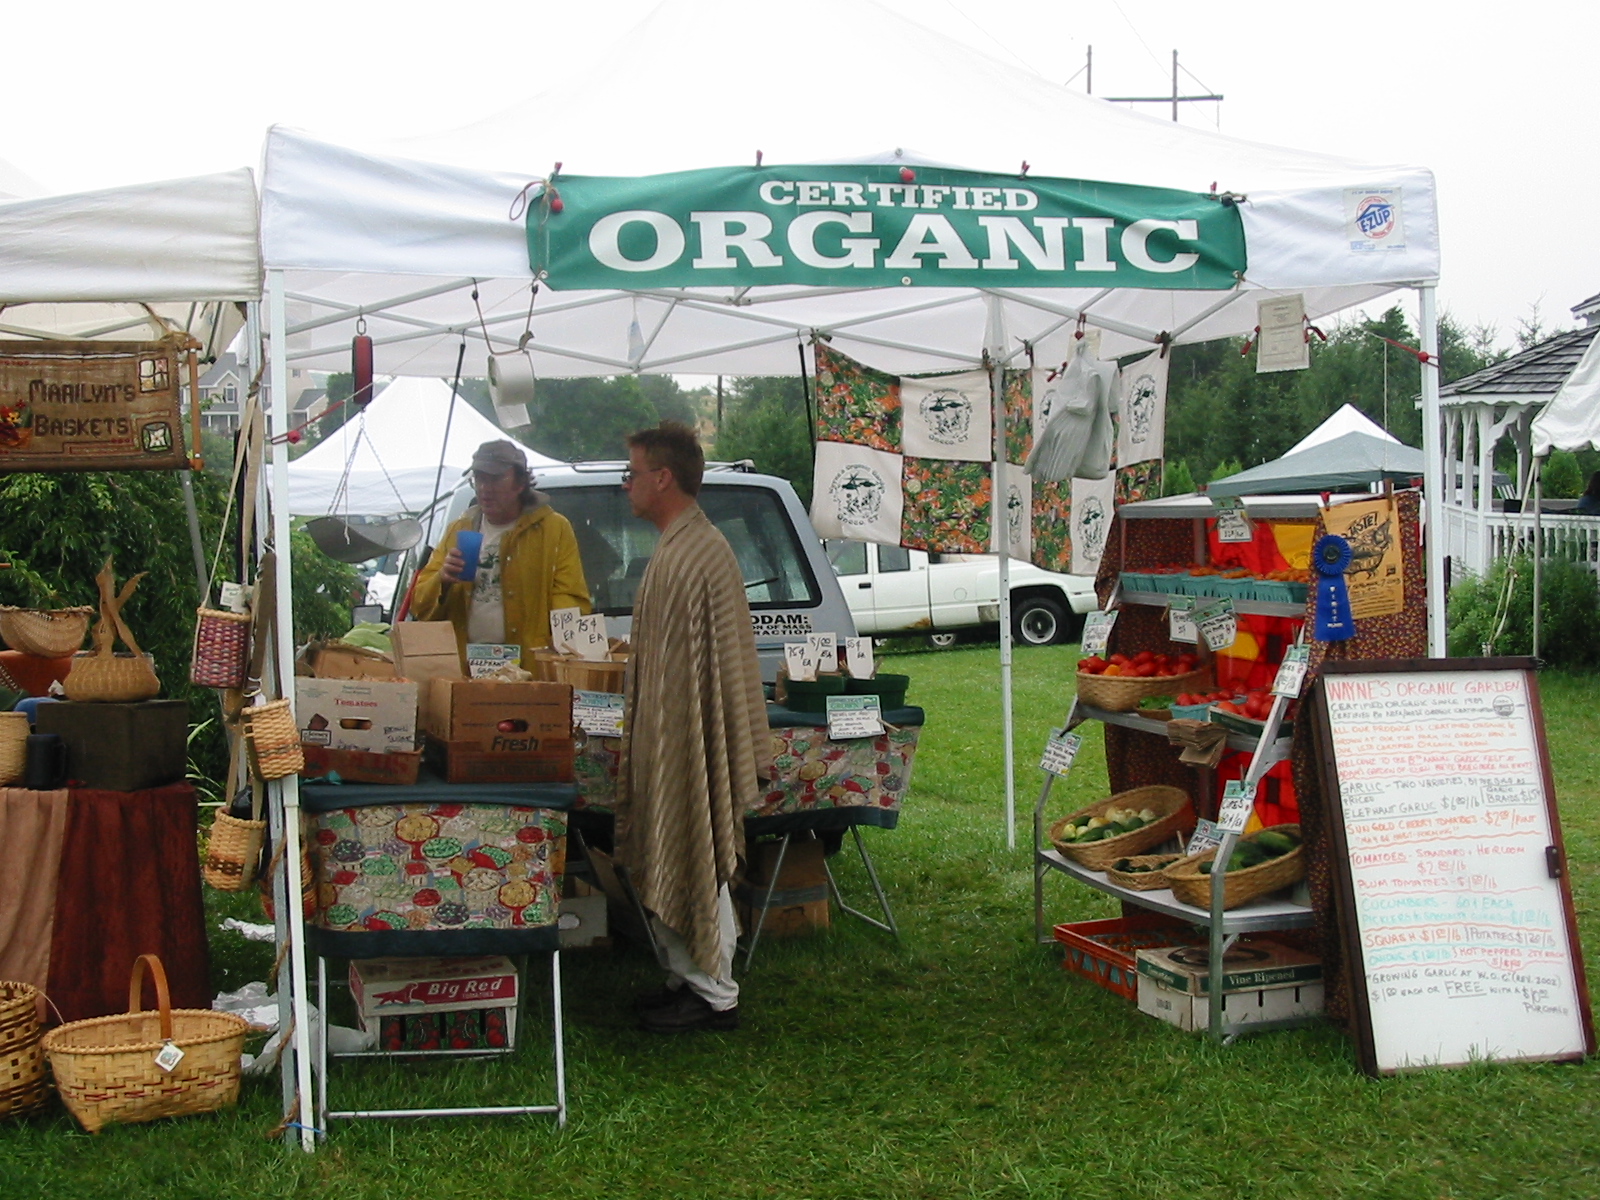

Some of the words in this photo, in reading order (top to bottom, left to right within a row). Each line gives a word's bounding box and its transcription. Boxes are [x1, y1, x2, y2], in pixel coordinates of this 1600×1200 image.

[758, 180, 1040, 212] CERTIFIED
[588, 209, 1200, 274] ORGANIC
[34, 413, 130, 438] BASKETS
[589, 632, 606, 645] EA
[802, 658, 812, 667] EA
[1326, 679, 1392, 702] WAYNE'S
[1396, 680, 1458, 697] ORGANIC
[1464, 680, 1521, 694] GARDEN
[334, 697, 379, 707] Tomatoes
[1330, 701, 1384, 711] CERTIFIED
[1385, 699, 1427, 709] ORGANIC
[1431, 698, 1460, 706] SINCE
[1333, 727, 1349, 735] ALL
[1415, 724, 1424, 732] IS
[490, 735, 540, 752] Fresh
[1339, 781, 1384, 795] GARLIC
[1393, 780, 1417, 790] TWO
[1345, 804, 1397, 820] ELEPHANT
[1398, 800, 1437, 814] GARLIC
[1346, 823, 1370, 835] SUN
[1371, 821, 1395, 832] GOLD
[1350, 851, 1407, 866] TOMATOES
[1357, 878, 1388, 889] PLUM
[1391, 876, 1449, 888] TOMATOES
[1364, 932, 1417, 948] SQUASH
[1459, 946, 1478, 957] HOT
[1229, 974, 1252, 986] Vine
[1424, 967, 1457, 977] GARLIC
[1460, 969, 1472, 978] AT
[427, 982, 460, 999] Big
[464, 977, 504, 993] Red
[1426, 985, 1441, 995] OR
[1444, 980, 1484, 996] FREE
